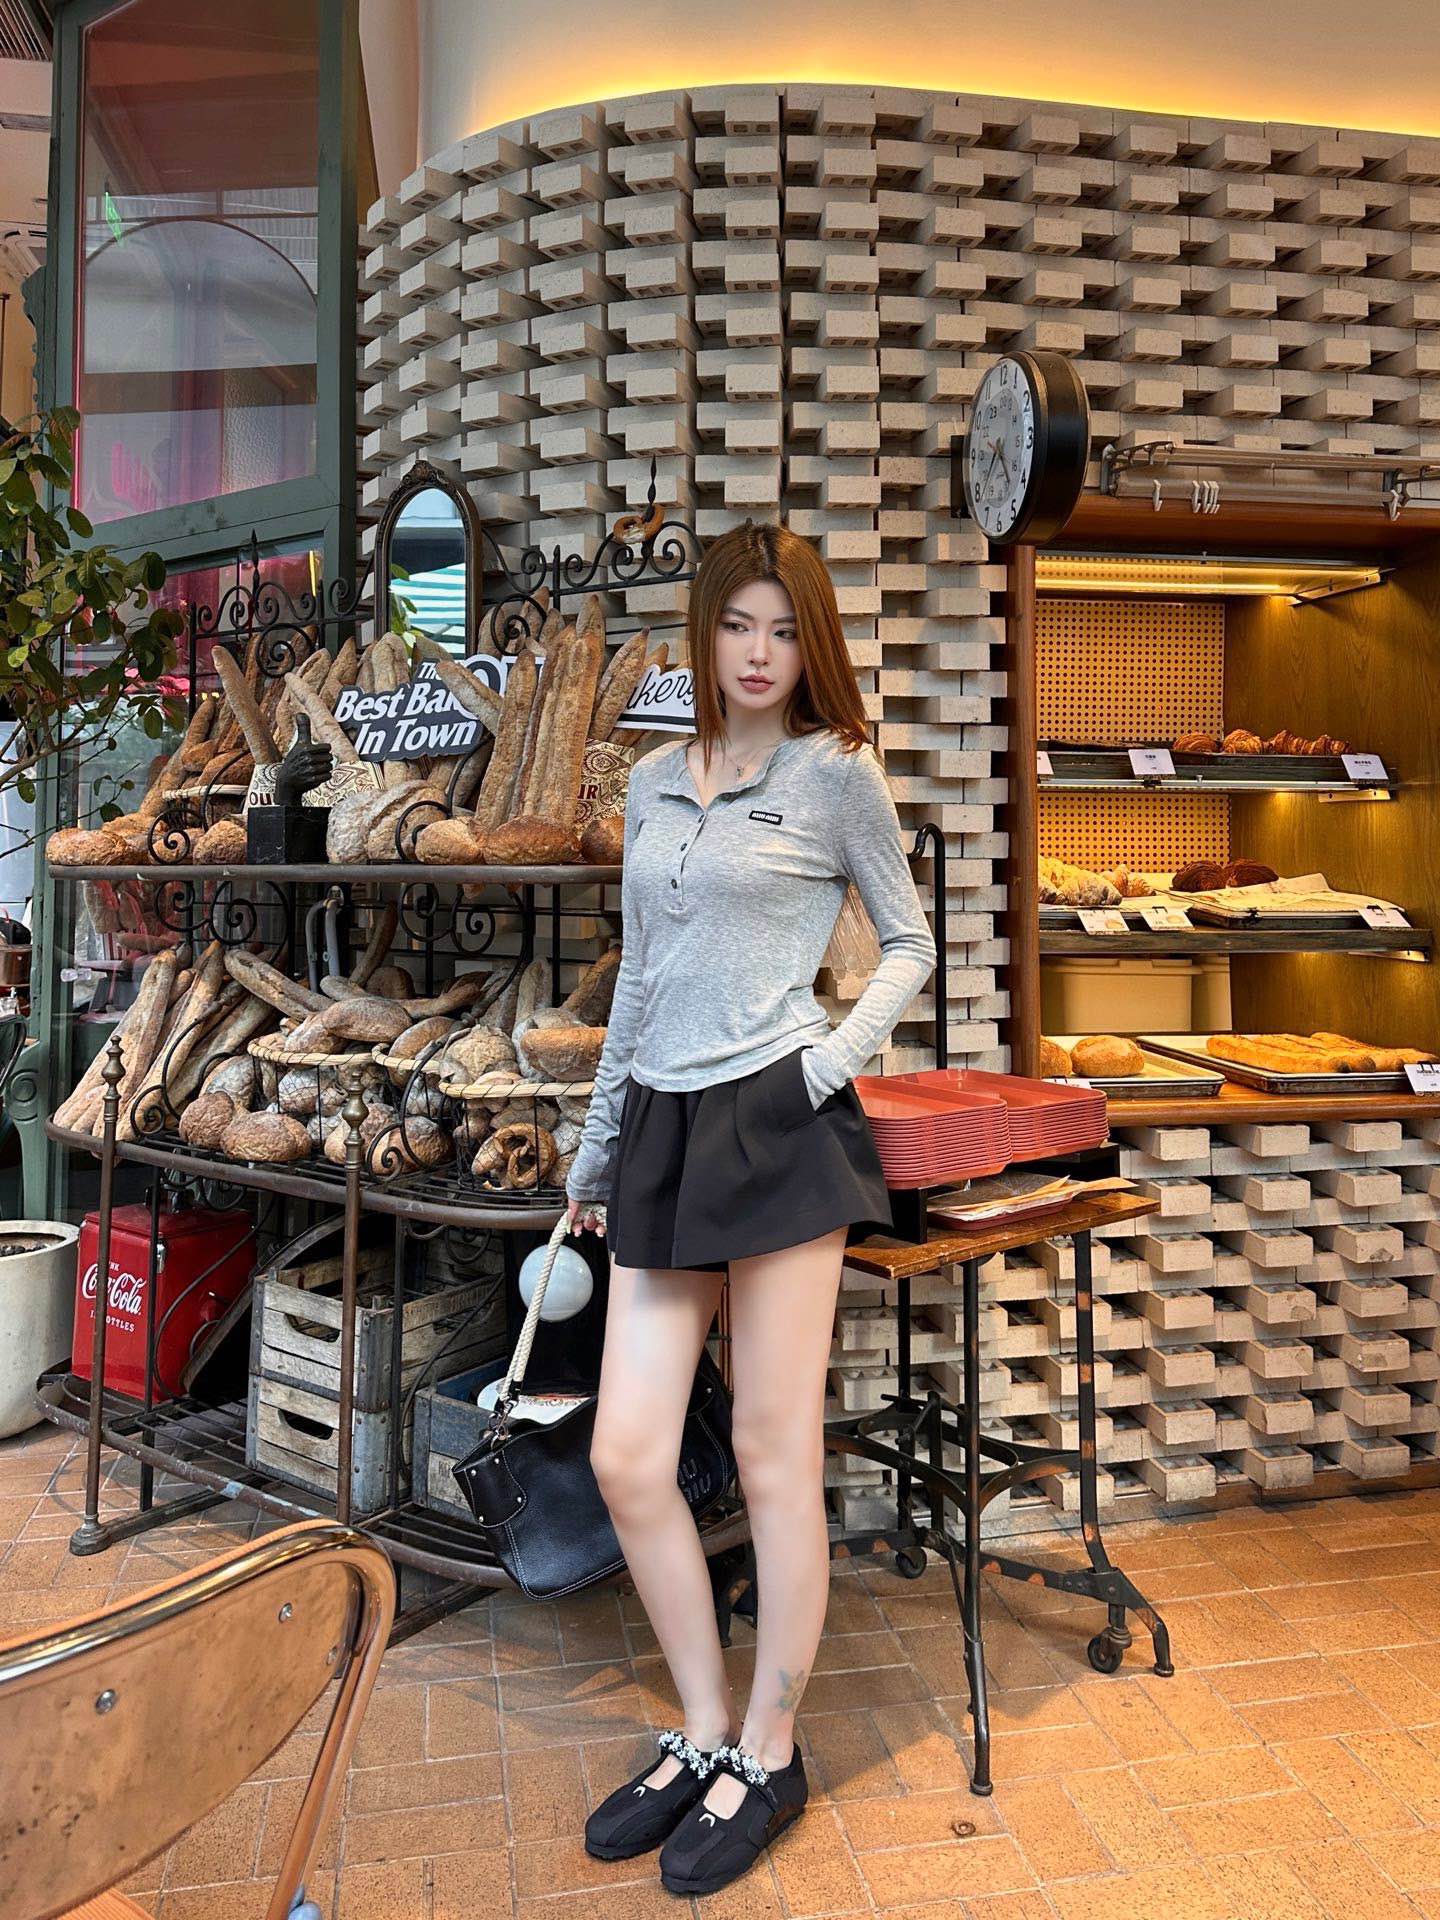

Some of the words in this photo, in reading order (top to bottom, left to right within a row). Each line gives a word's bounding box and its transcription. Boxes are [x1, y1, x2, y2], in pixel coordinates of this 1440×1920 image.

[1000, 364, 1008, 387] 12
[1013, 367, 1018, 389] 1
[985, 380, 992, 401] 11
[1023, 390, 1031, 413] 2
[990, 406, 997, 420] 23
[1026, 426, 1034, 449] 3
[971, 448, 976, 469] 9
[1021, 468, 1027, 490] 4
[975, 482, 981, 503] 8
[984, 506, 990, 529] 7
[1011, 499, 1017, 521] 5
[996, 511, 1003, 533] 6
[418, 661, 442, 681] Th
[334, 687, 406, 723] Best
[354, 723, 387, 756] In
[390, 717, 477, 754] Town
[105, 1315, 135, 1332] OTTLES
